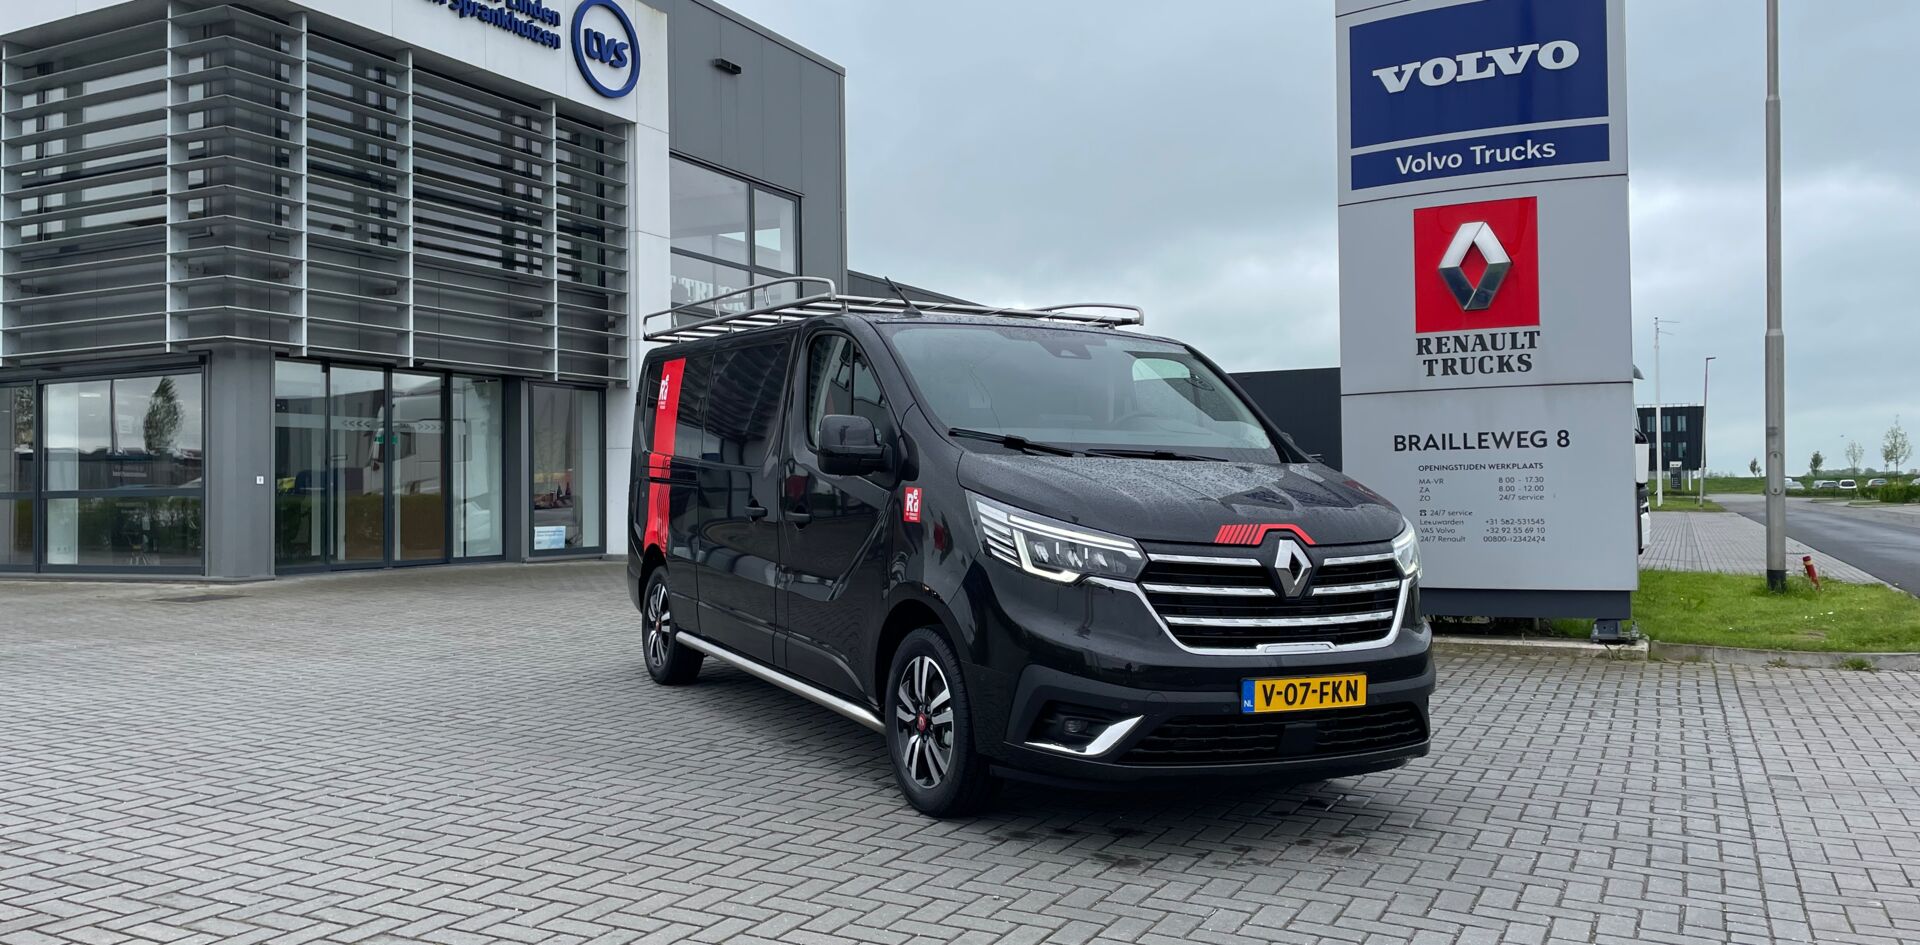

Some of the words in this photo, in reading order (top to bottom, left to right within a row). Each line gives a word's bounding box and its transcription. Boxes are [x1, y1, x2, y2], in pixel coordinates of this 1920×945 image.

[584, 28, 628, 69] LVS
[1372, 40, 1580, 94] VOLVO
[1396, 152, 1463, 175] Volvo
[1470, 139, 1557, 165] Trucks
[1416, 330, 1541, 356] RENAULT
[1423, 353, 1533, 377] TRUCKS
[1394, 430, 1548, 452] BRAILLEWEG
[1556, 429, 1570, 448] 8
[1418, 463, 1486, 472] OPENINGSTIJDEN
[1488, 462, 1544, 471] WERKPLAATS
[1499, 493, 1516, 501] 24/7
[1518, 493, 1545, 501] service
[1420, 535, 1436, 543] 24/7
[1437, 535, 1466, 543] Renault
[1243, 700, 1253, 708] NL
[1262, 679, 1359, 707] V-07-FKN
